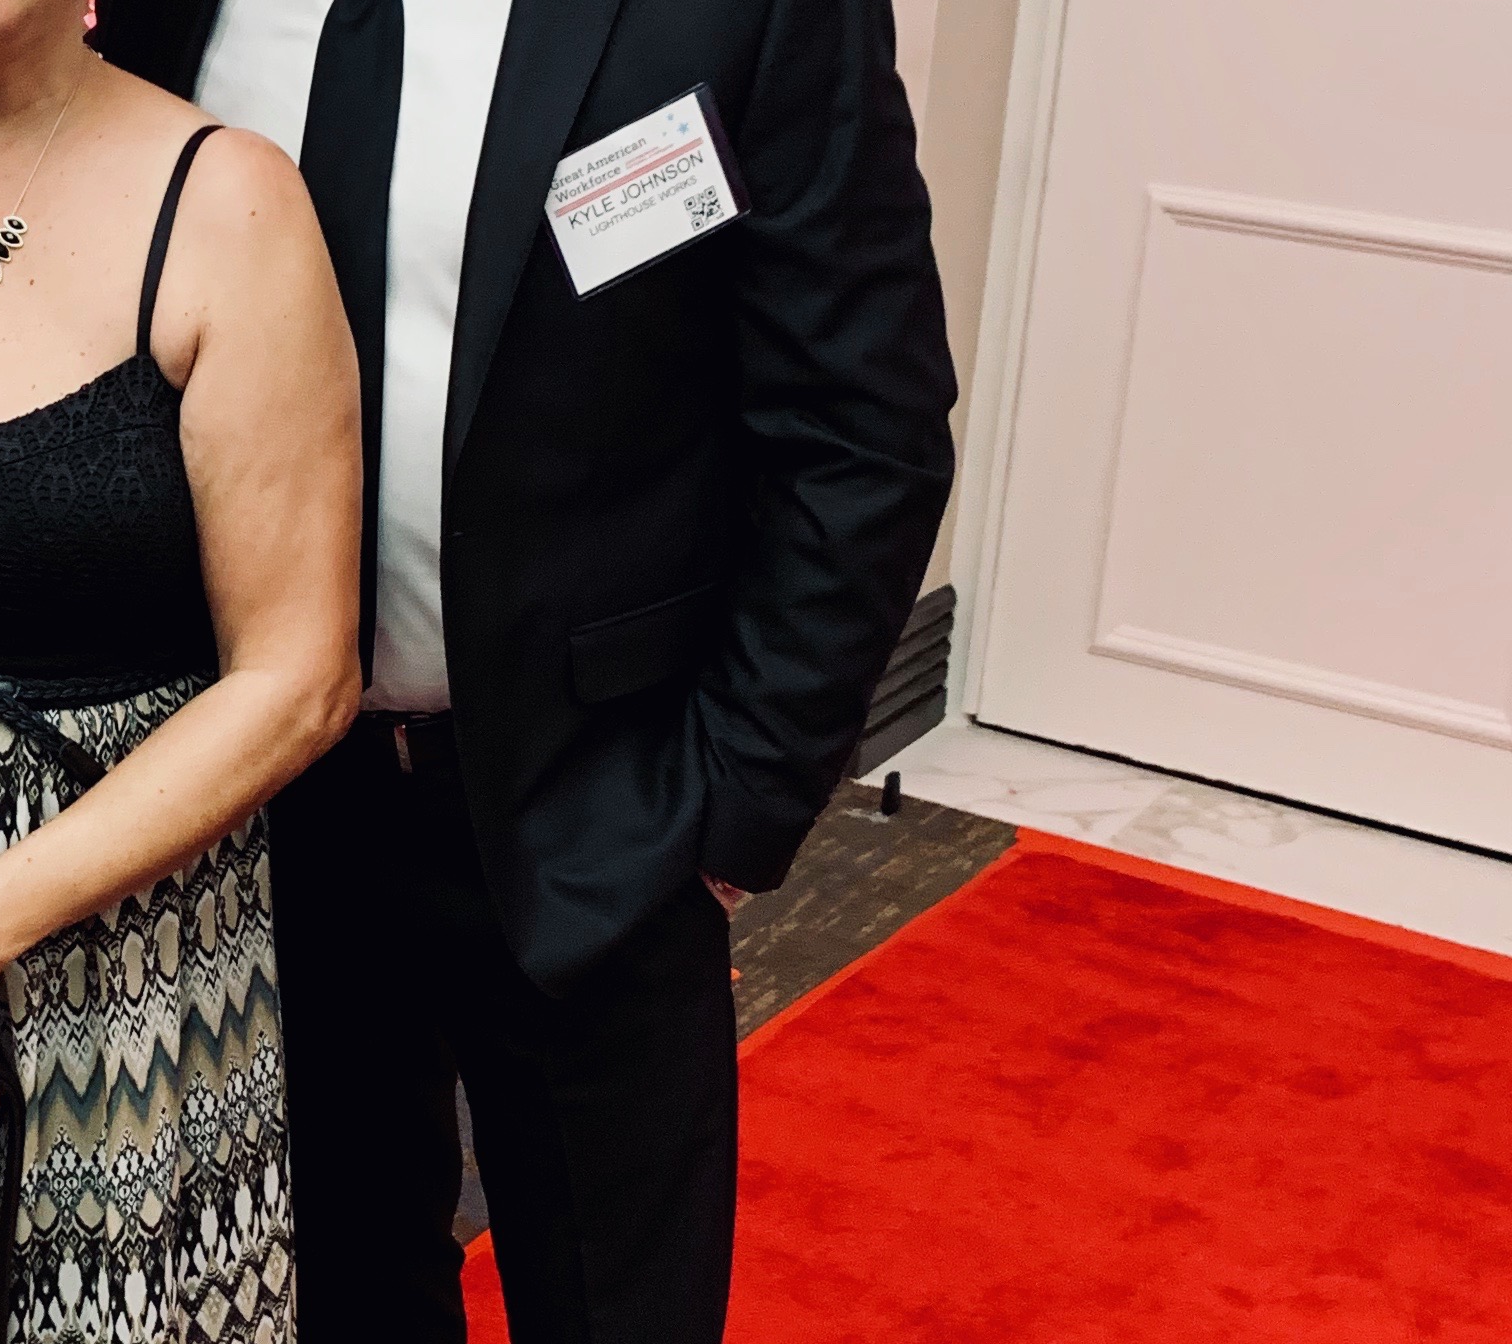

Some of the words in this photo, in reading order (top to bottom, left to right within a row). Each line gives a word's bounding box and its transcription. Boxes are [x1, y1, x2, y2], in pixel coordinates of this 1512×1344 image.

[550, 167, 584, 191] Great
[586, 137, 647, 173] American
[554, 166, 622, 203] Workforce
[568, 196, 616, 230] KYLE
[620, 150, 703, 205] JOHNSON
[589, 196, 657, 236] LIGHTHOUSE
[658, 175, 698, 201] WORKS
